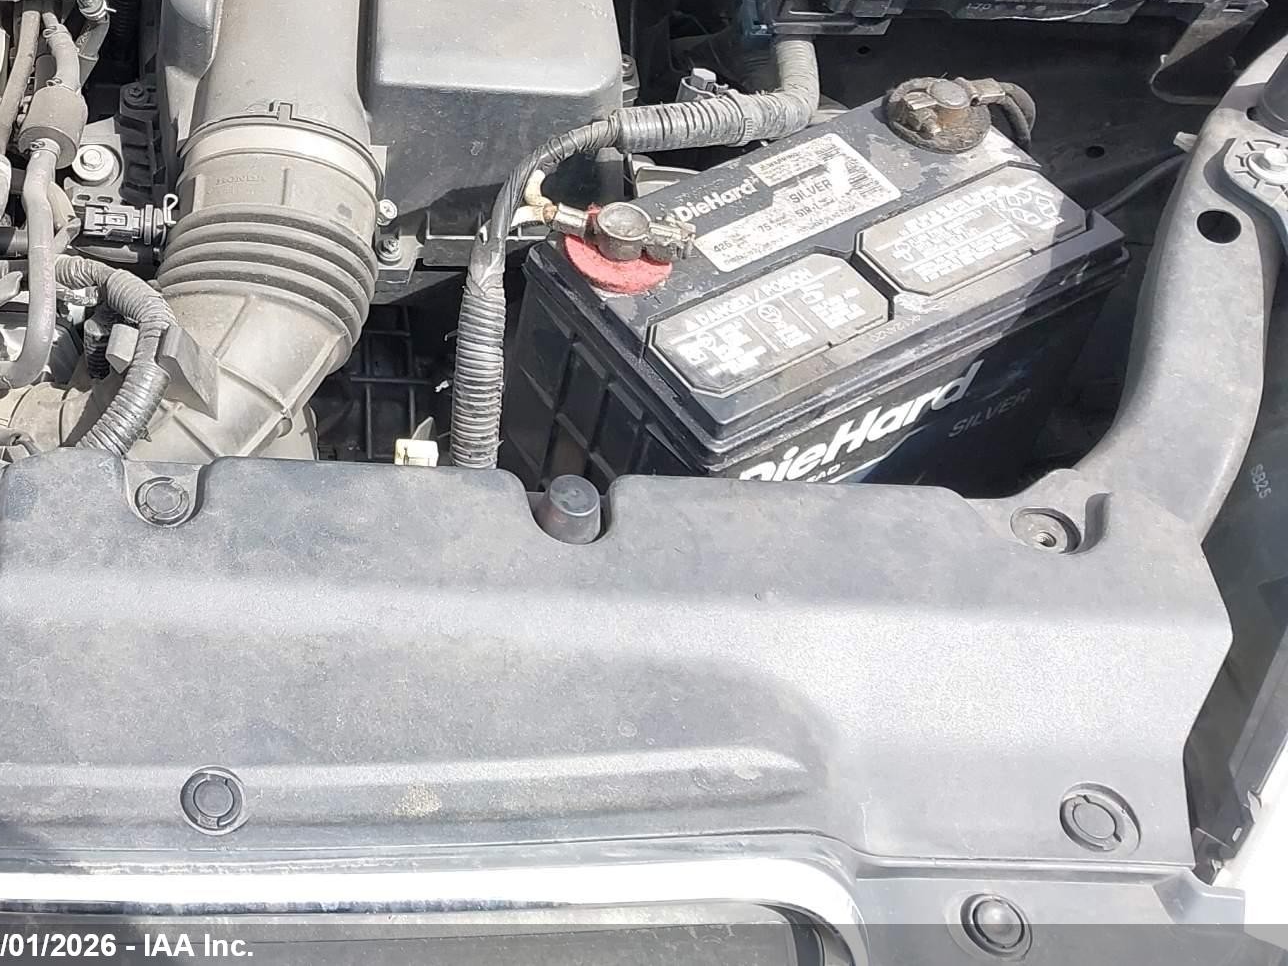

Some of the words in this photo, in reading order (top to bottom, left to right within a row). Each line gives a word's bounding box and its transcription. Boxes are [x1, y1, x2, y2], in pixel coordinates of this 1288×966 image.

[673, 177, 758, 222] DieHard
[789, 178, 833, 204] SILVER
[696, 291, 754, 325] DANGER
[948, 387, 1032, 438] SILVER
